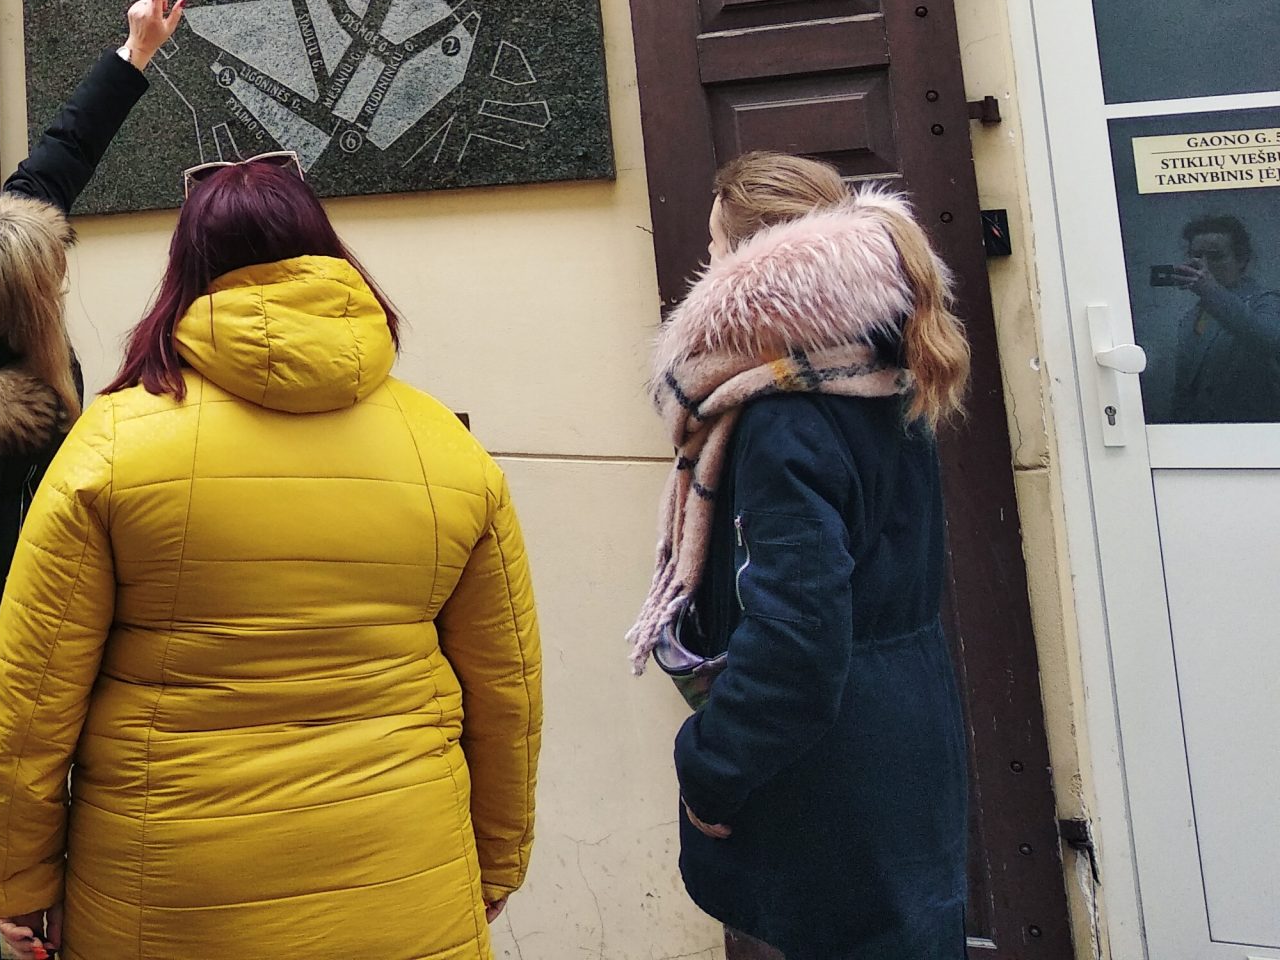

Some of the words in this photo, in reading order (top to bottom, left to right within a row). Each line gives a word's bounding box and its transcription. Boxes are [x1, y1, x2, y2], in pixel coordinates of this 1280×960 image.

[225, 97, 258, 131] PYLIMO
[1186, 133, 1250, 148] GAONO
[1254, 132, 1272, 144] G.
[1160, 154, 1226, 169] STIKLIŲ
[1229, 148, 1280, 165] VIEŠB
[1155, 169, 1254, 186] TARNYBINIS
